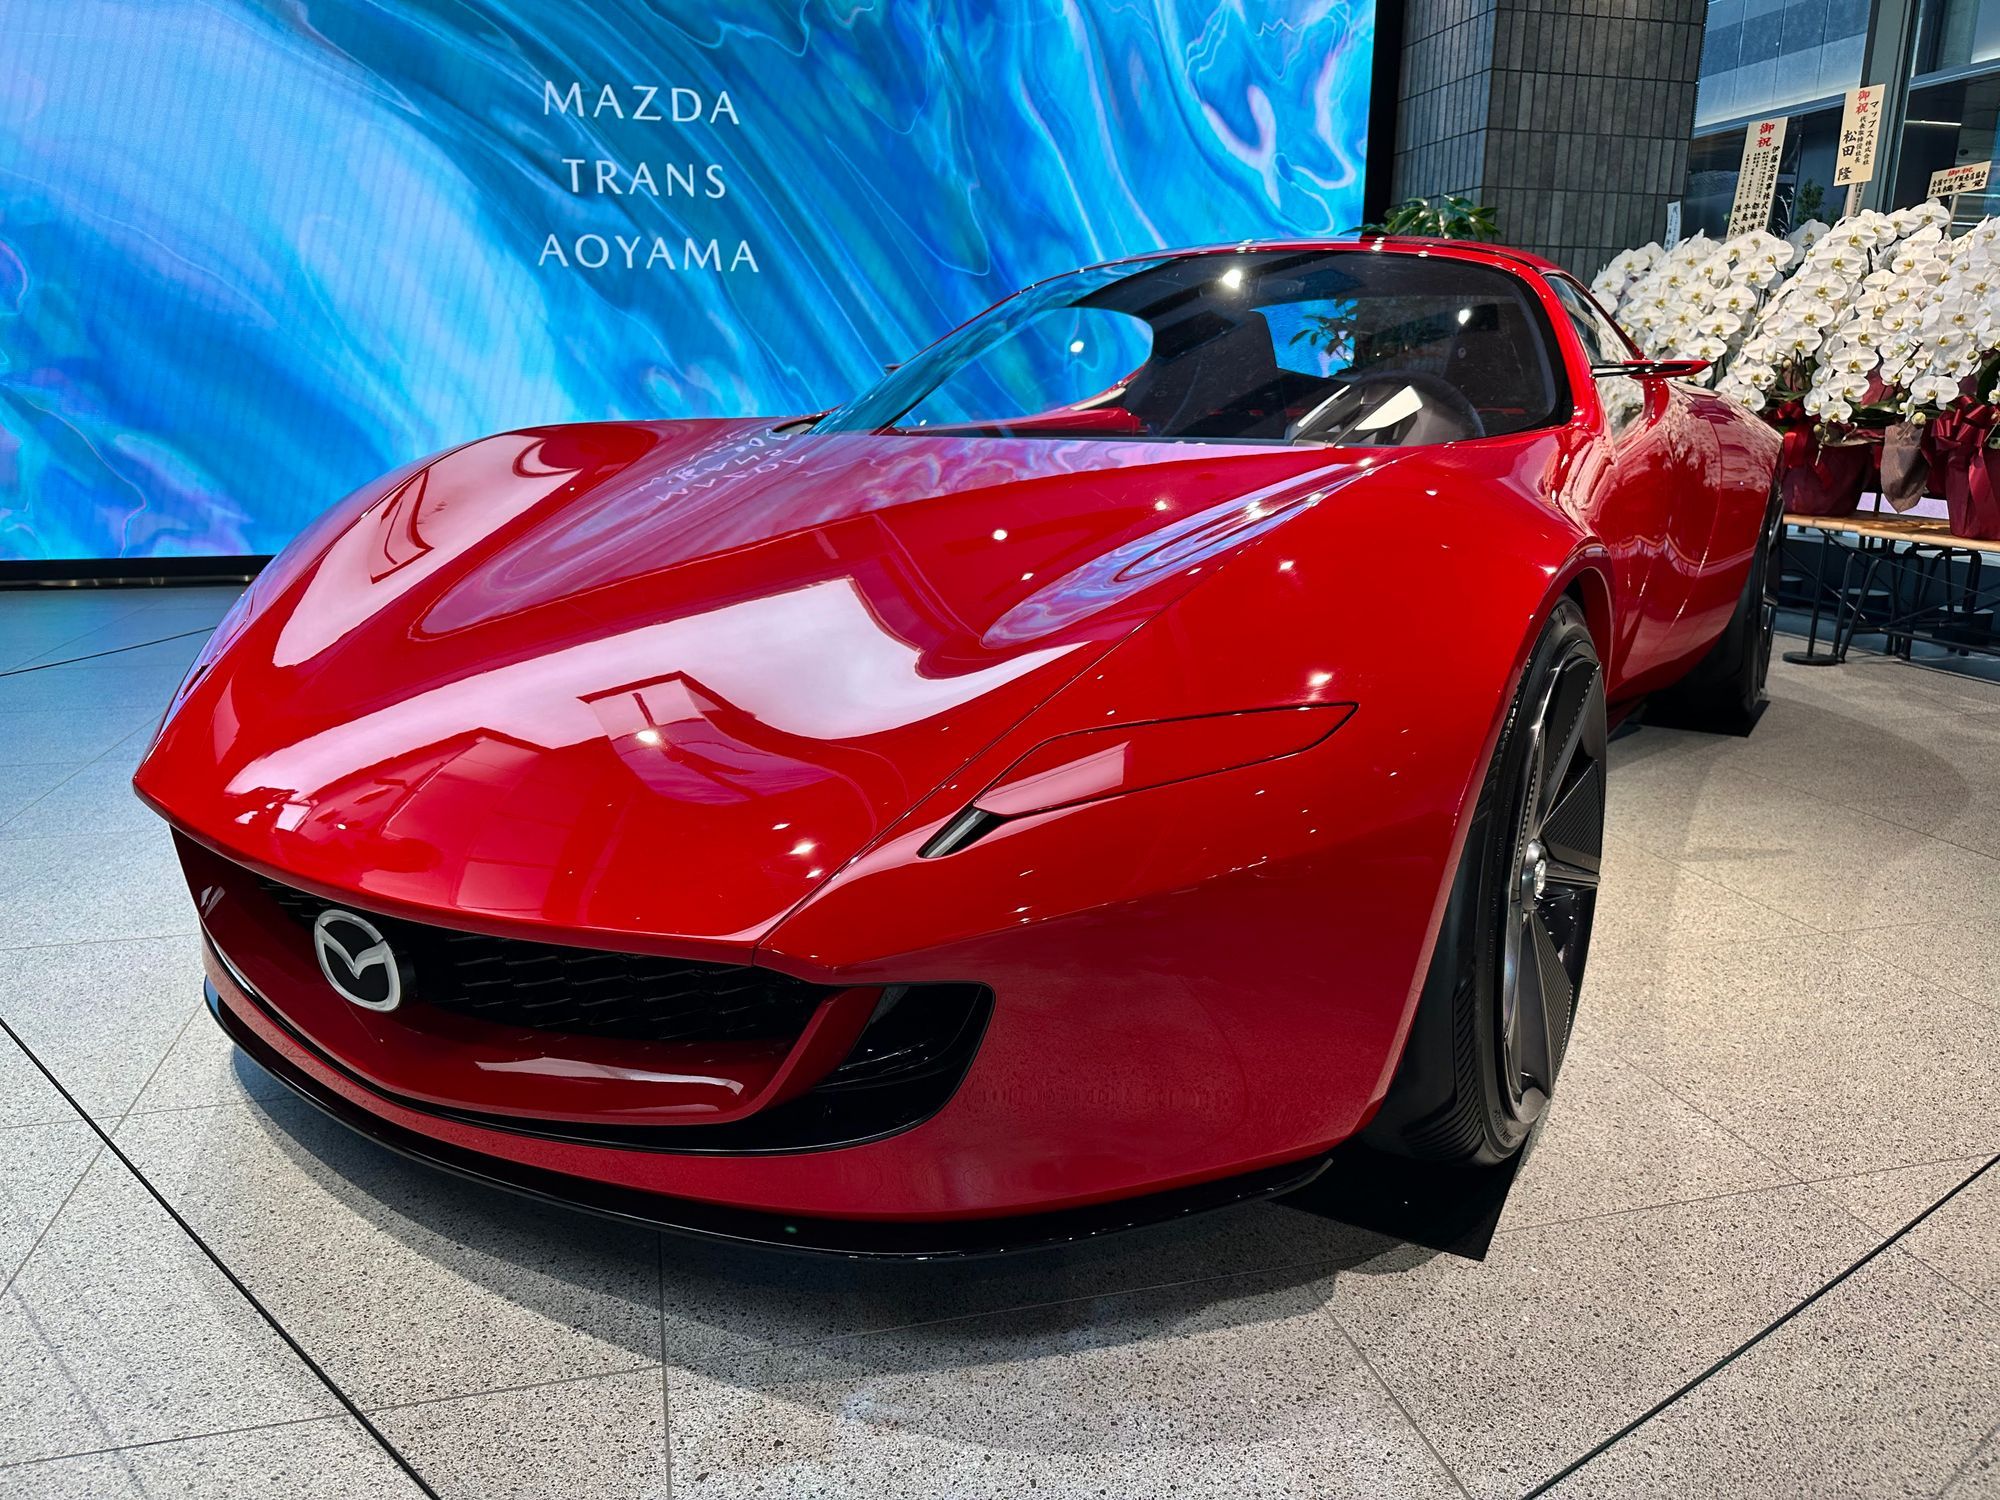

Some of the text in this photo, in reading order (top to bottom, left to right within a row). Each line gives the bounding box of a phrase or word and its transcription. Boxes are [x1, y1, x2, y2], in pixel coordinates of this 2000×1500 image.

[543, 80, 740, 125] MAZDA
[1855, 90, 1870, 115] 御祝
[1756, 122, 1776, 148] 御祝
[561, 158, 727, 199] TRANS
[1757, 145, 1781, 229] 伊藤忠商事株式会社
[538, 233, 760, 273] AOYAMA
